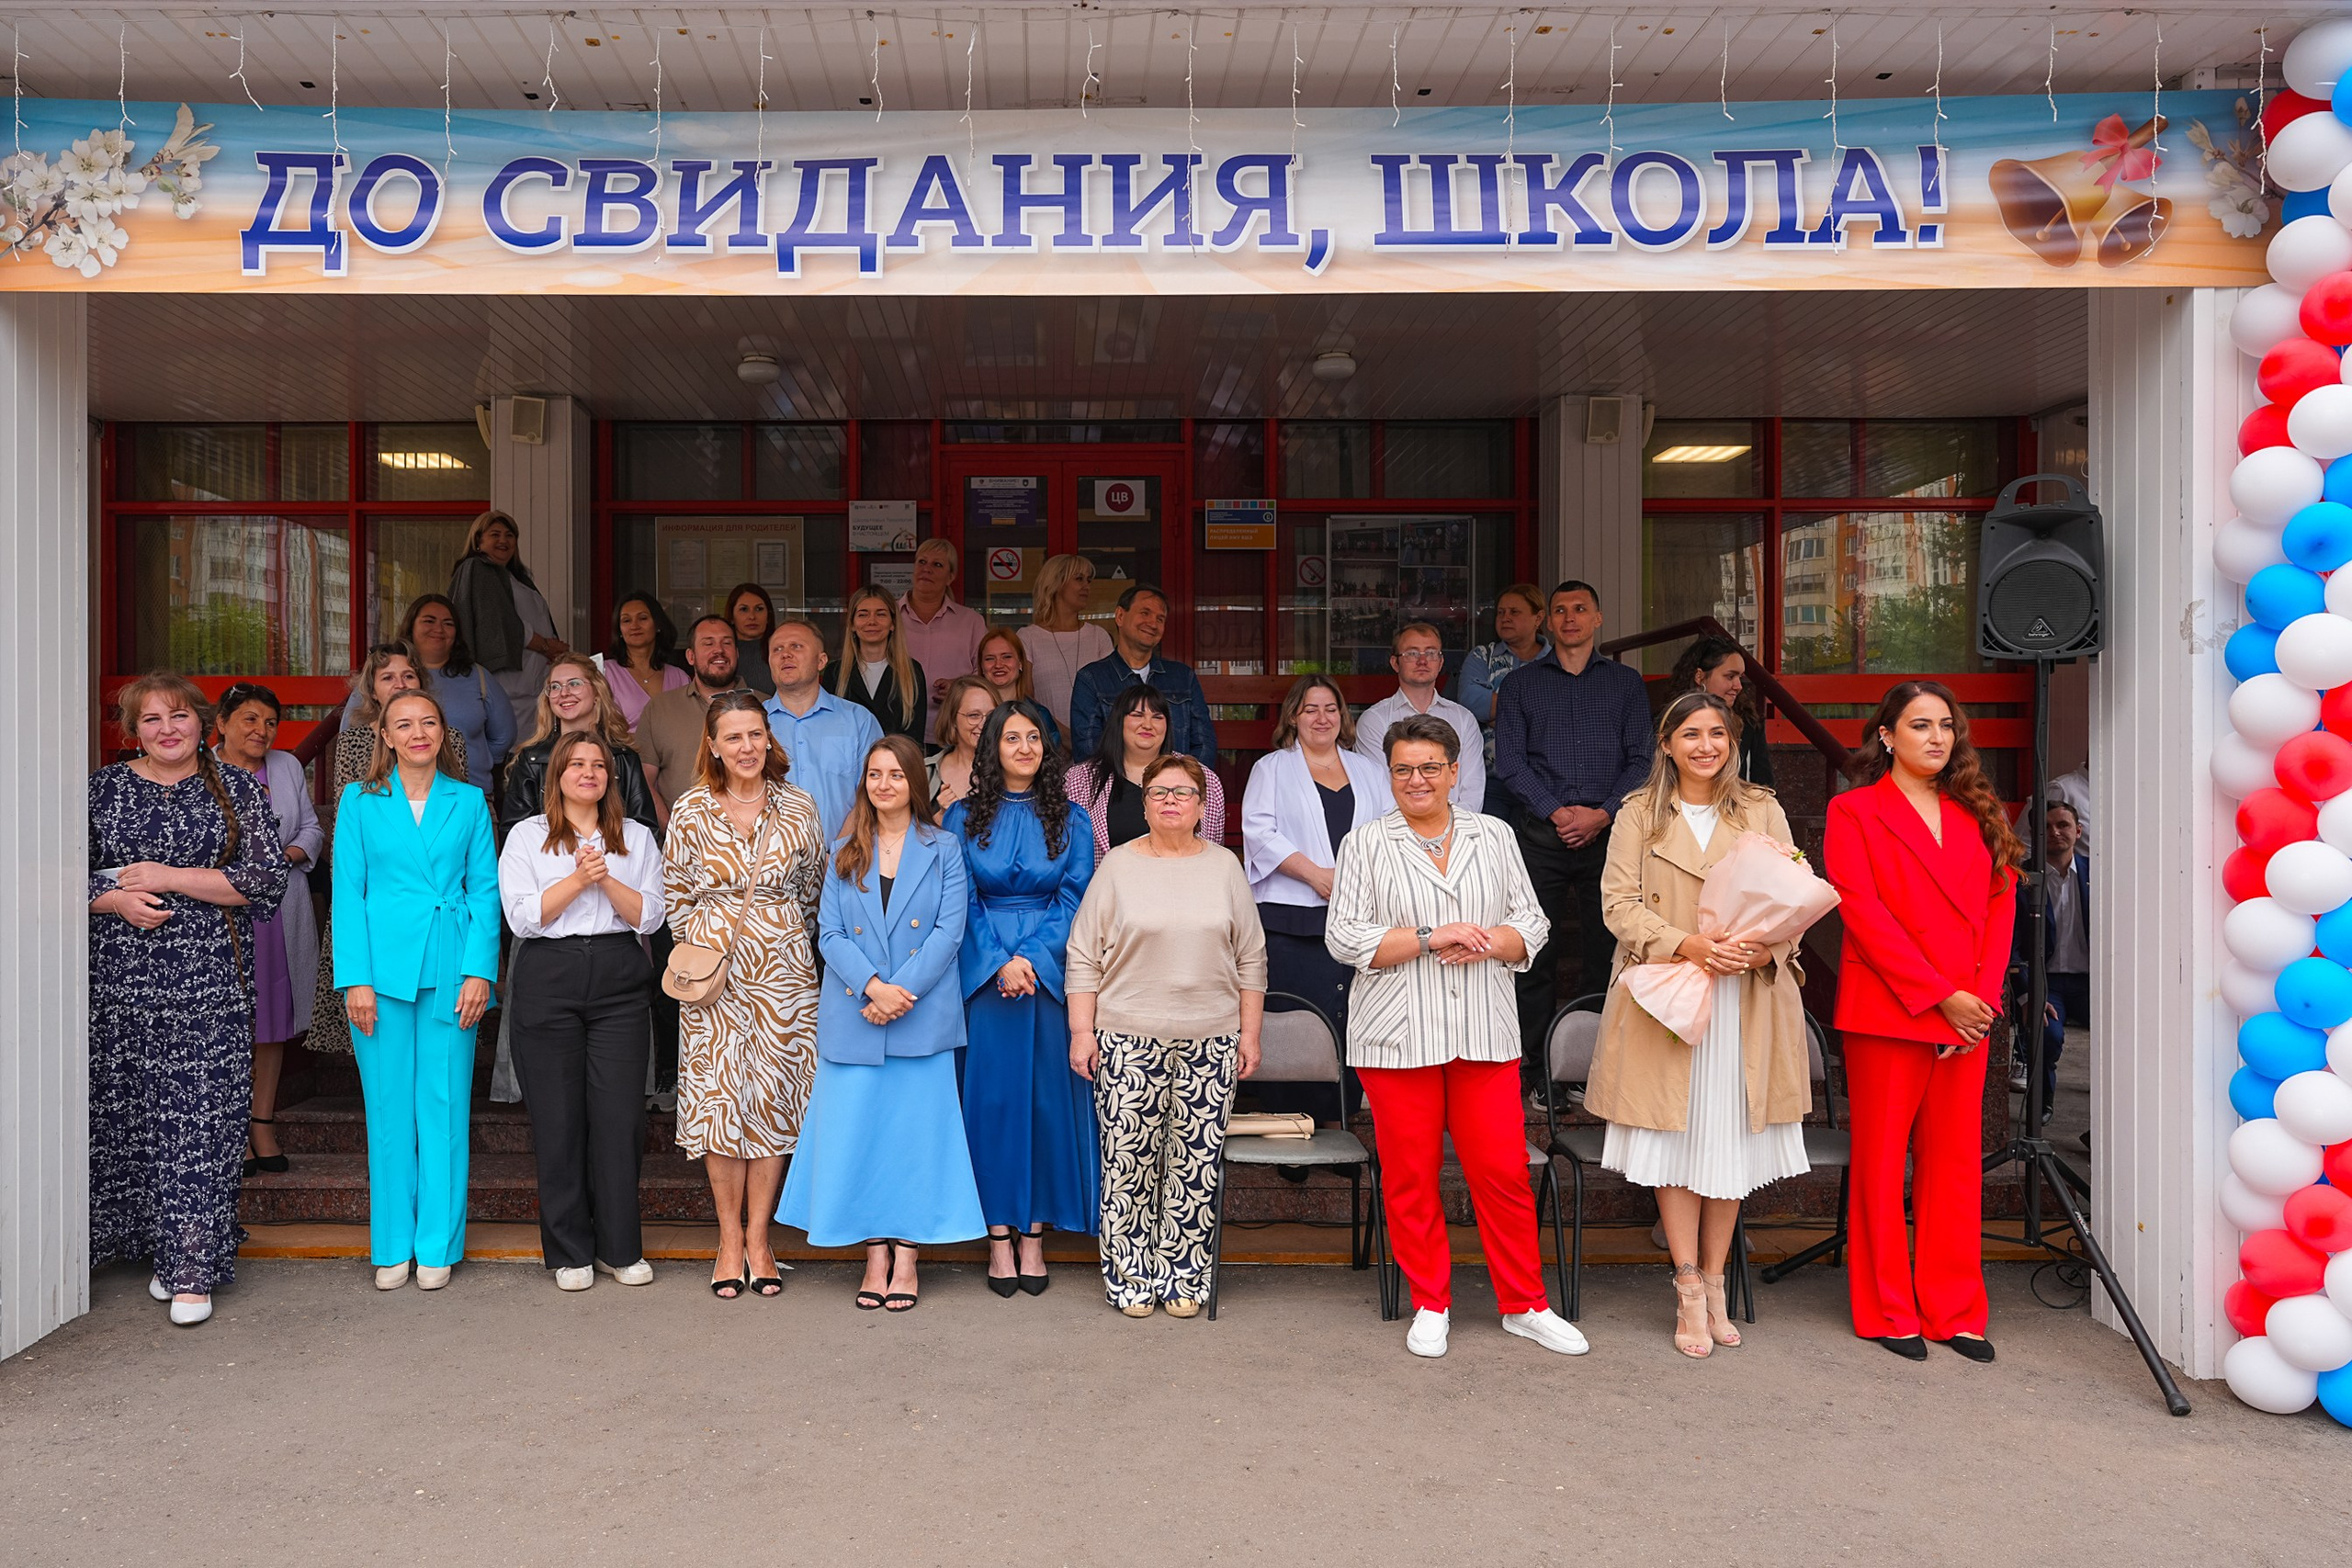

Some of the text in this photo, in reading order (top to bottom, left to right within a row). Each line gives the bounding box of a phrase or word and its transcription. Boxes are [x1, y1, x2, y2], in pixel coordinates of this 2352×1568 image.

[240, 144, 1948, 278] ДО СВИДАНИЯ, ШКОЛА!
[1112, 491, 1128, 504] ЦВ
[662, 523, 797, 532] ИНФОРМАЦИЯ ДЛЯ РОДИТЕЛЕЙ
